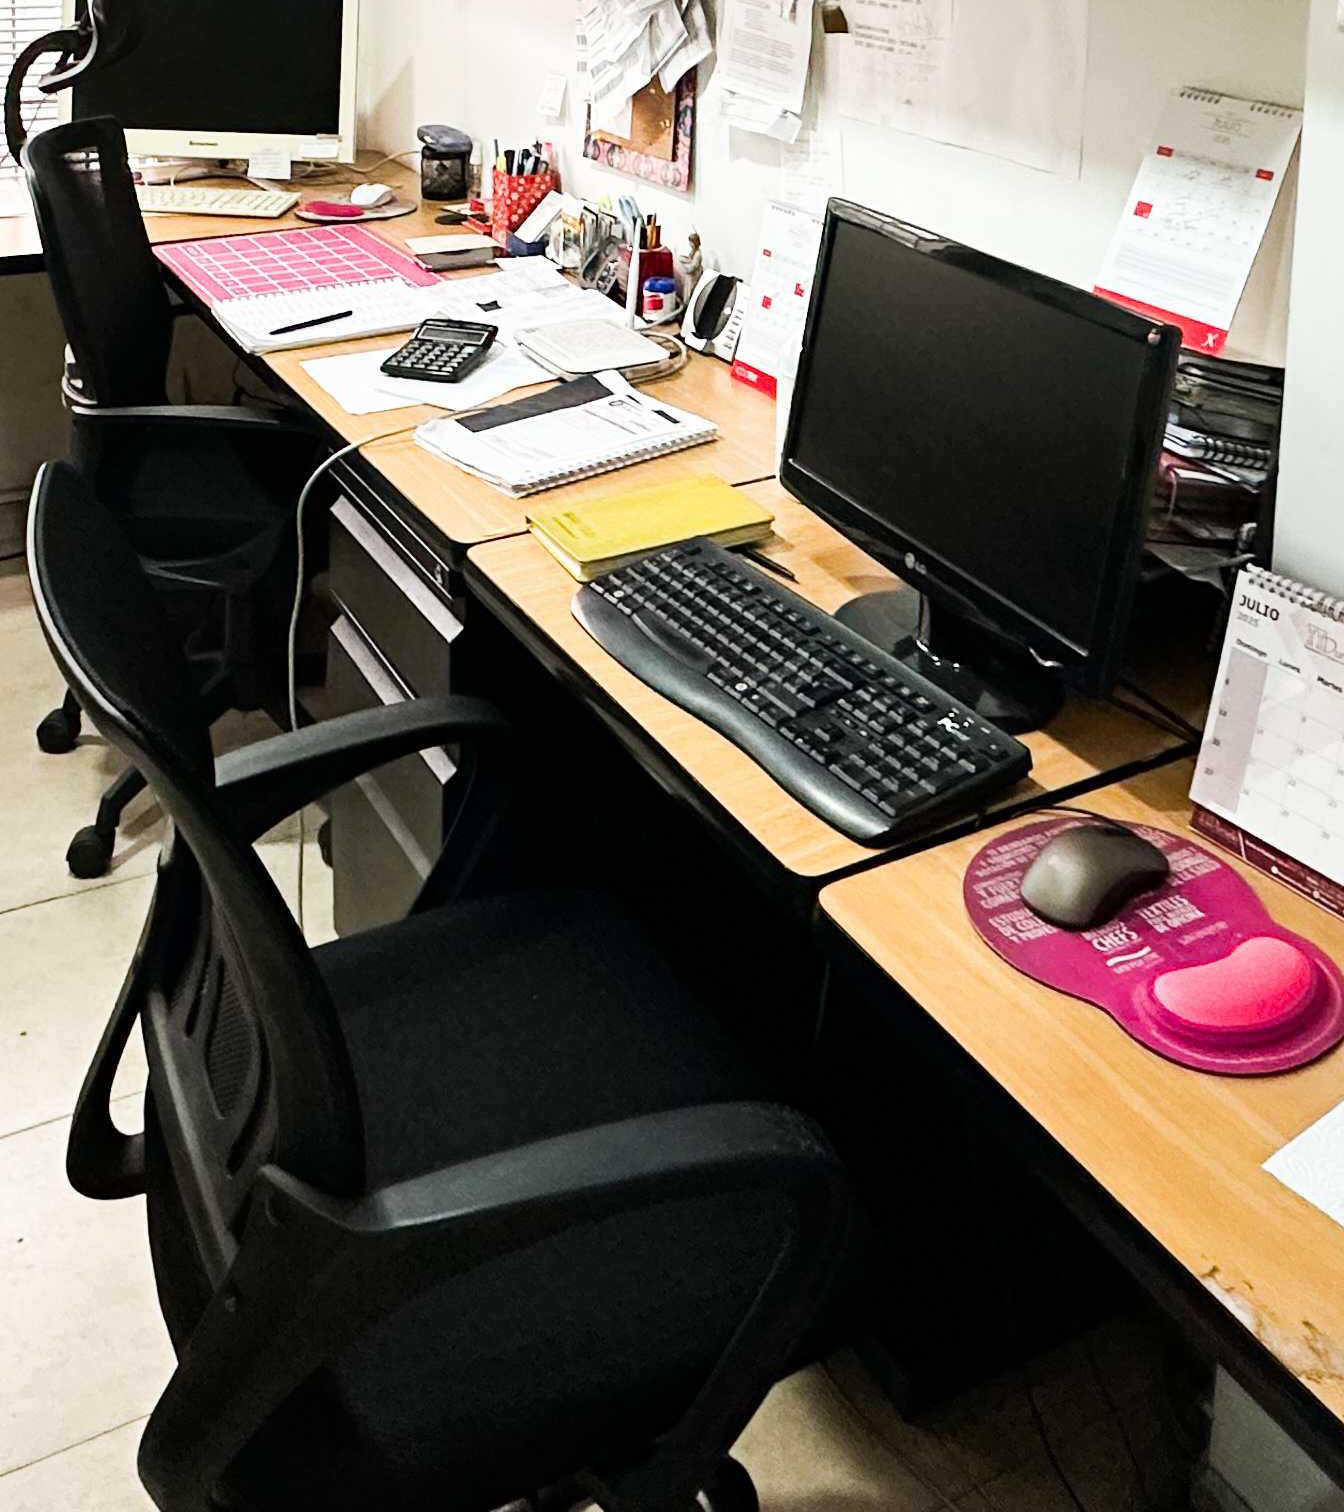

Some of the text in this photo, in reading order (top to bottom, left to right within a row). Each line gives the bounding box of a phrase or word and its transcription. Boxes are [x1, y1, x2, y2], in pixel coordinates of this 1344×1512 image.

[1239, 595, 1280, 621] JULIO
[1279, 658, 1301, 674] Lunes
[1317, 675, 1343, 693] Martes
[1091, 926, 1138, 952] CHEFS
